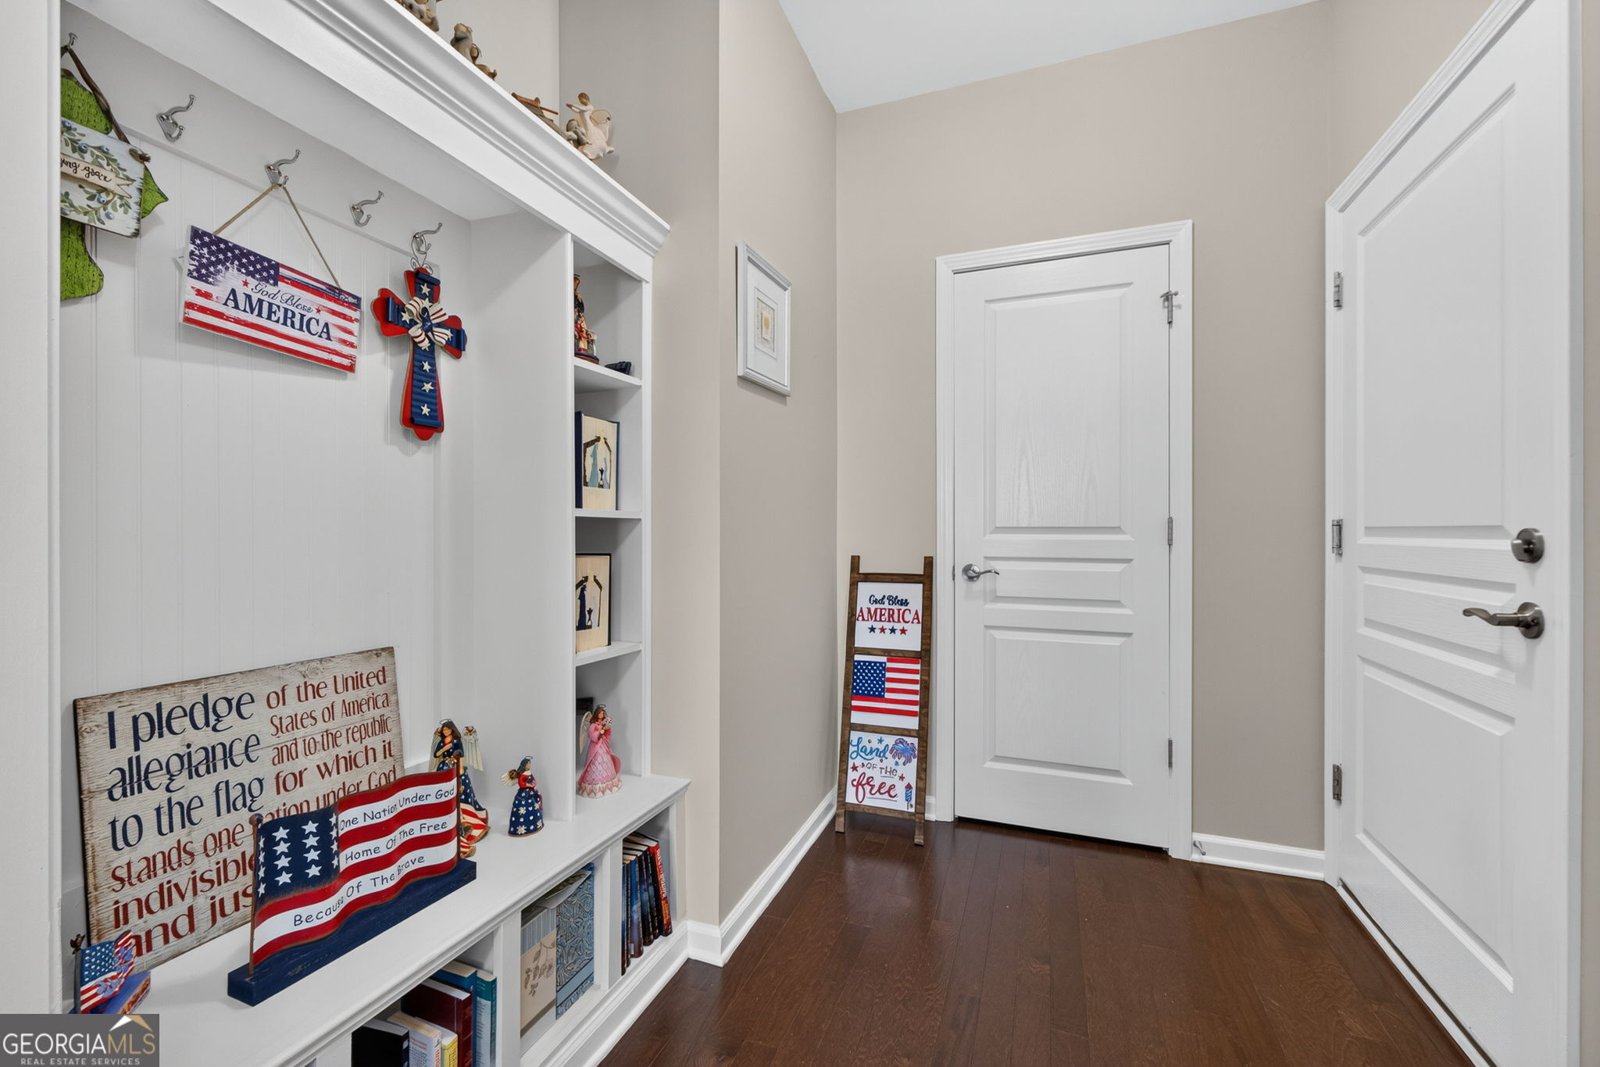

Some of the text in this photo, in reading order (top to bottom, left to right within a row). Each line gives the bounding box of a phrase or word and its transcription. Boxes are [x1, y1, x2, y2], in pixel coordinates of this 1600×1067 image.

[223, 287, 332, 341] AMERICA
[251, 281, 314, 314] God Bless
[856, 607, 921, 624] AMERICA
[868, 594, 910, 607] God Bless
[266, 666, 387, 709] of the United
[107, 691, 255, 752] I pledge
[270, 692, 390, 737] States of America
[271, 714, 393, 766] and to the republic
[850, 736, 889, 761] Land
[107, 733, 260, 801] allegiance
[274, 739, 394, 796] for which it
[851, 772, 898, 803] free
[866, 762, 877, 770] OF
[107, 777, 265, 851] to the flag
[111, 838, 195, 892] stands
[203, 823, 245, 858] one
[368, 765, 397, 790] God
[340, 787, 455, 832] One Nation Under God
[345, 820, 448, 864] Home Of The Free
[293, 855, 425, 927] Because Of The Brave
